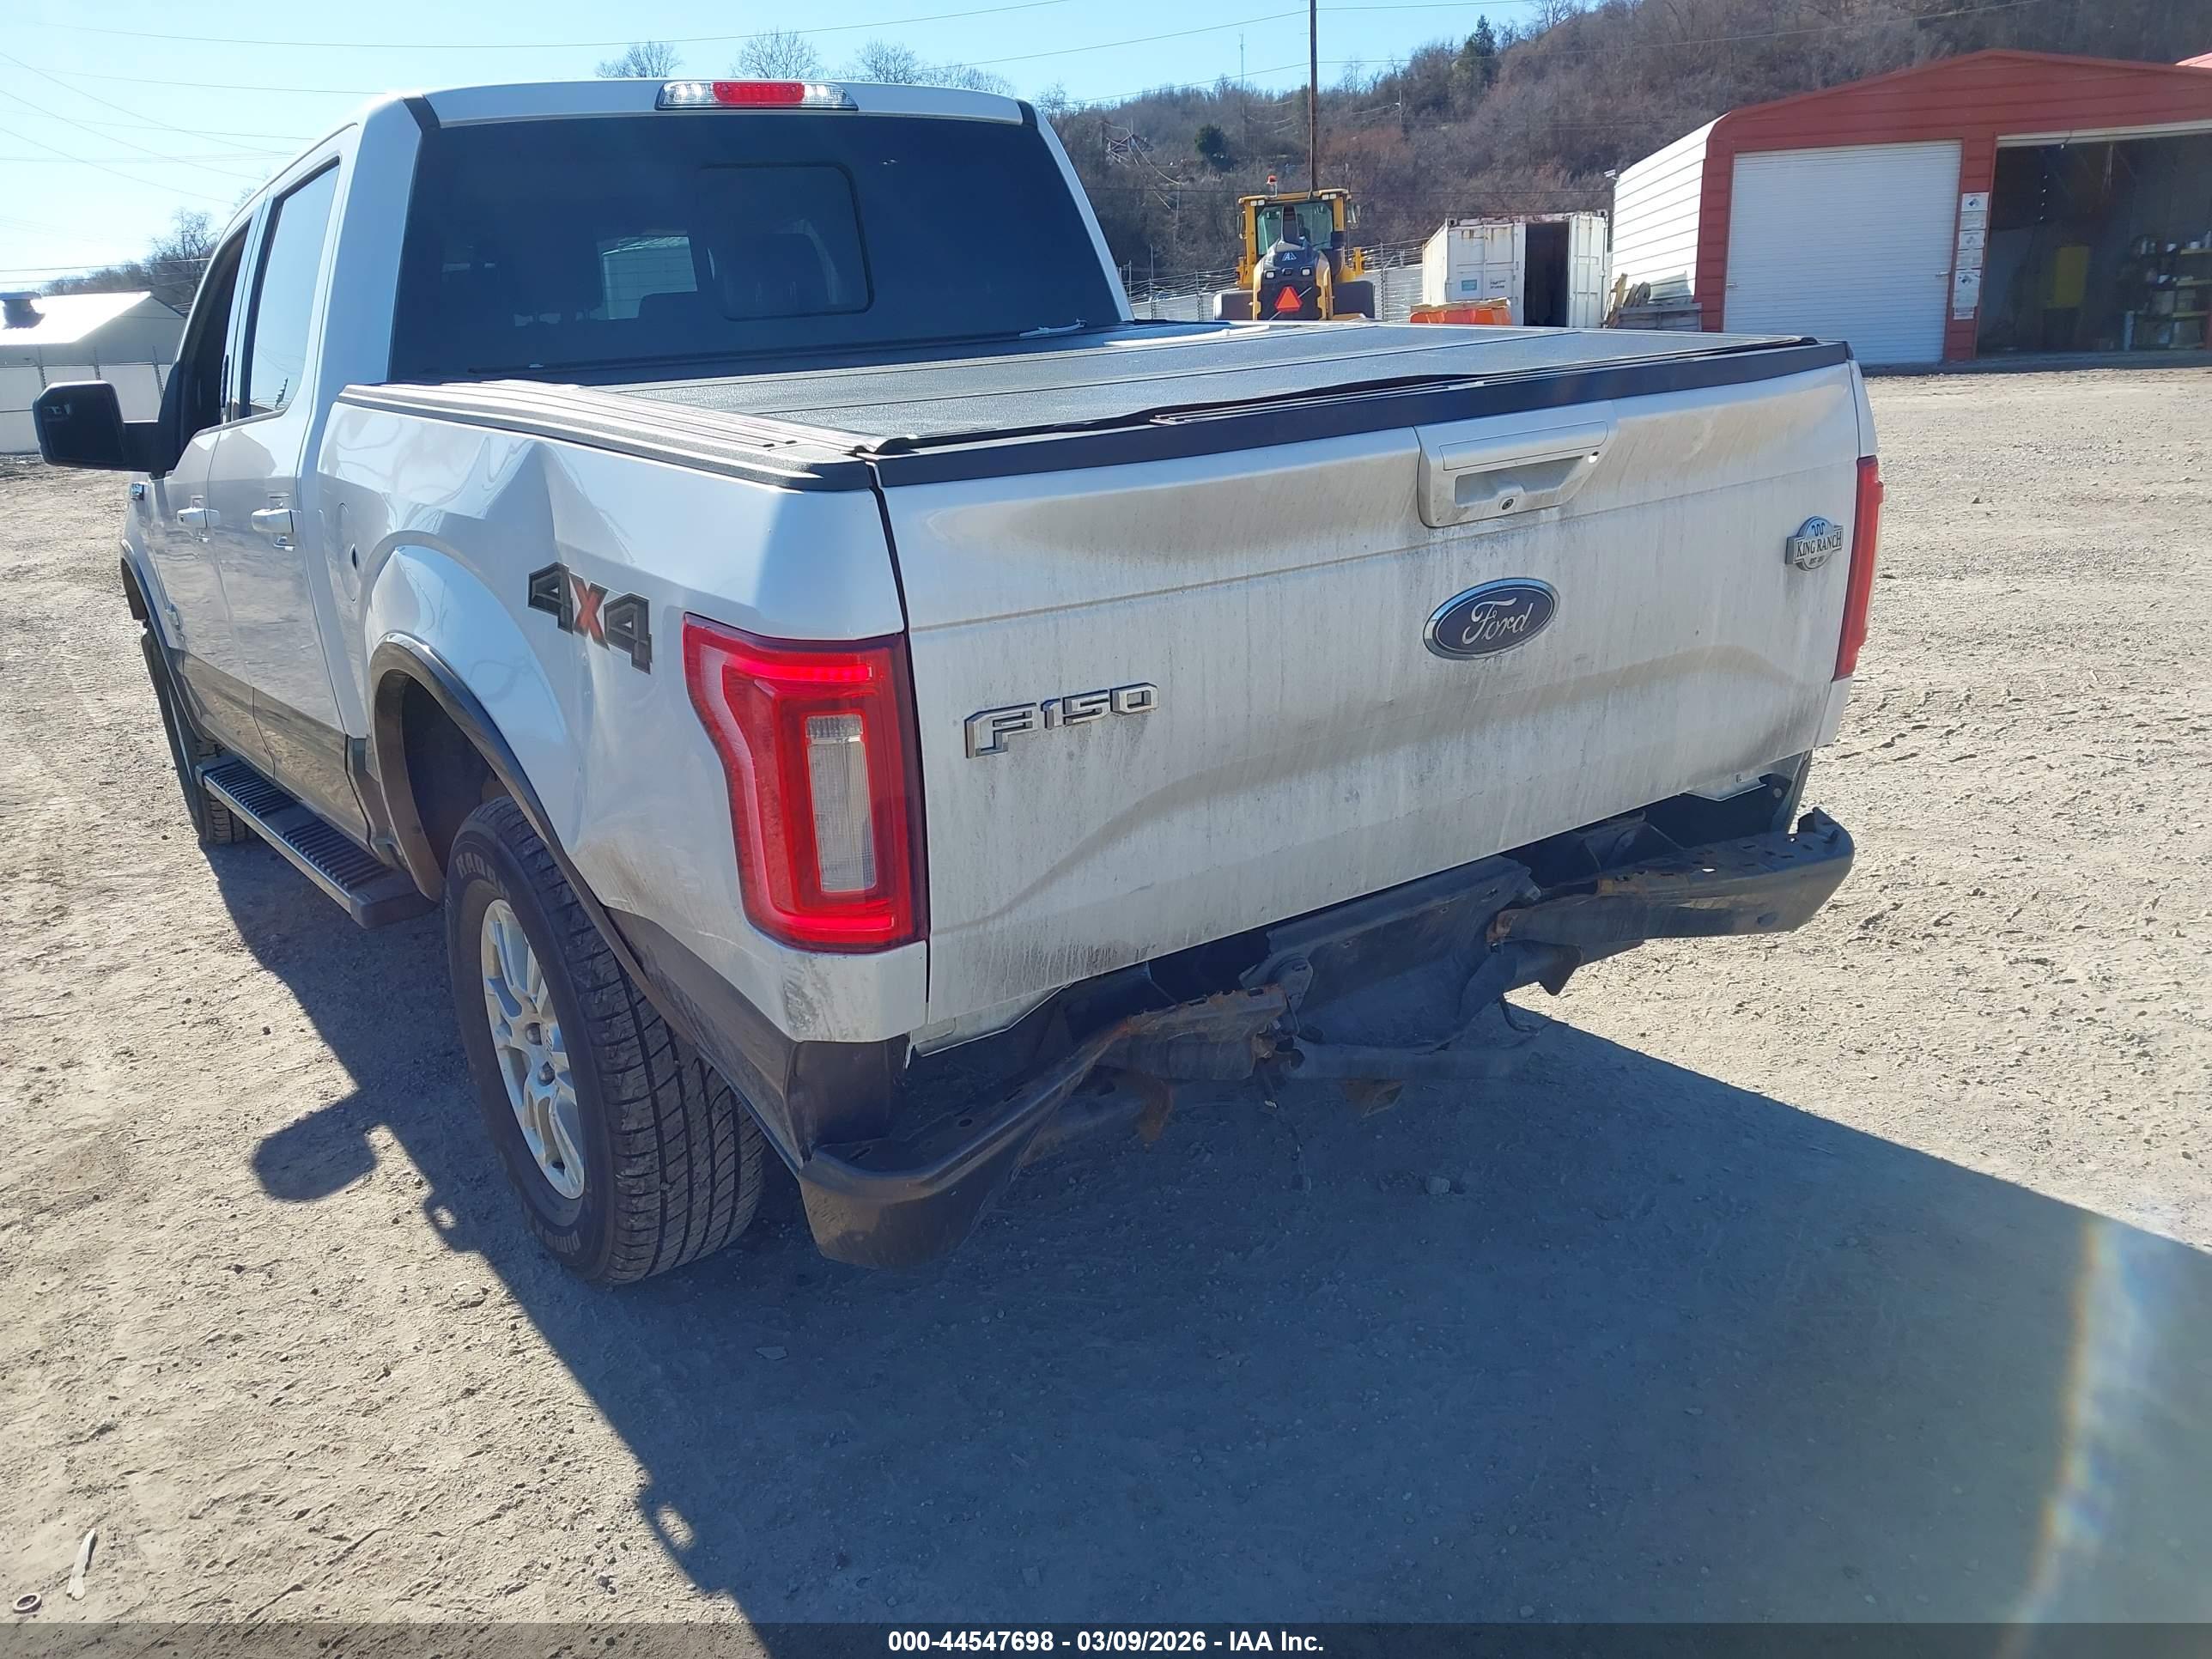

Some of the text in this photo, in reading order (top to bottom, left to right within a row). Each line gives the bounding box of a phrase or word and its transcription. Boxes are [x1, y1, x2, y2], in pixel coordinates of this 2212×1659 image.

[1796, 531, 1842, 557] KING RANCH
[1462, 597, 1534, 645] Ford
